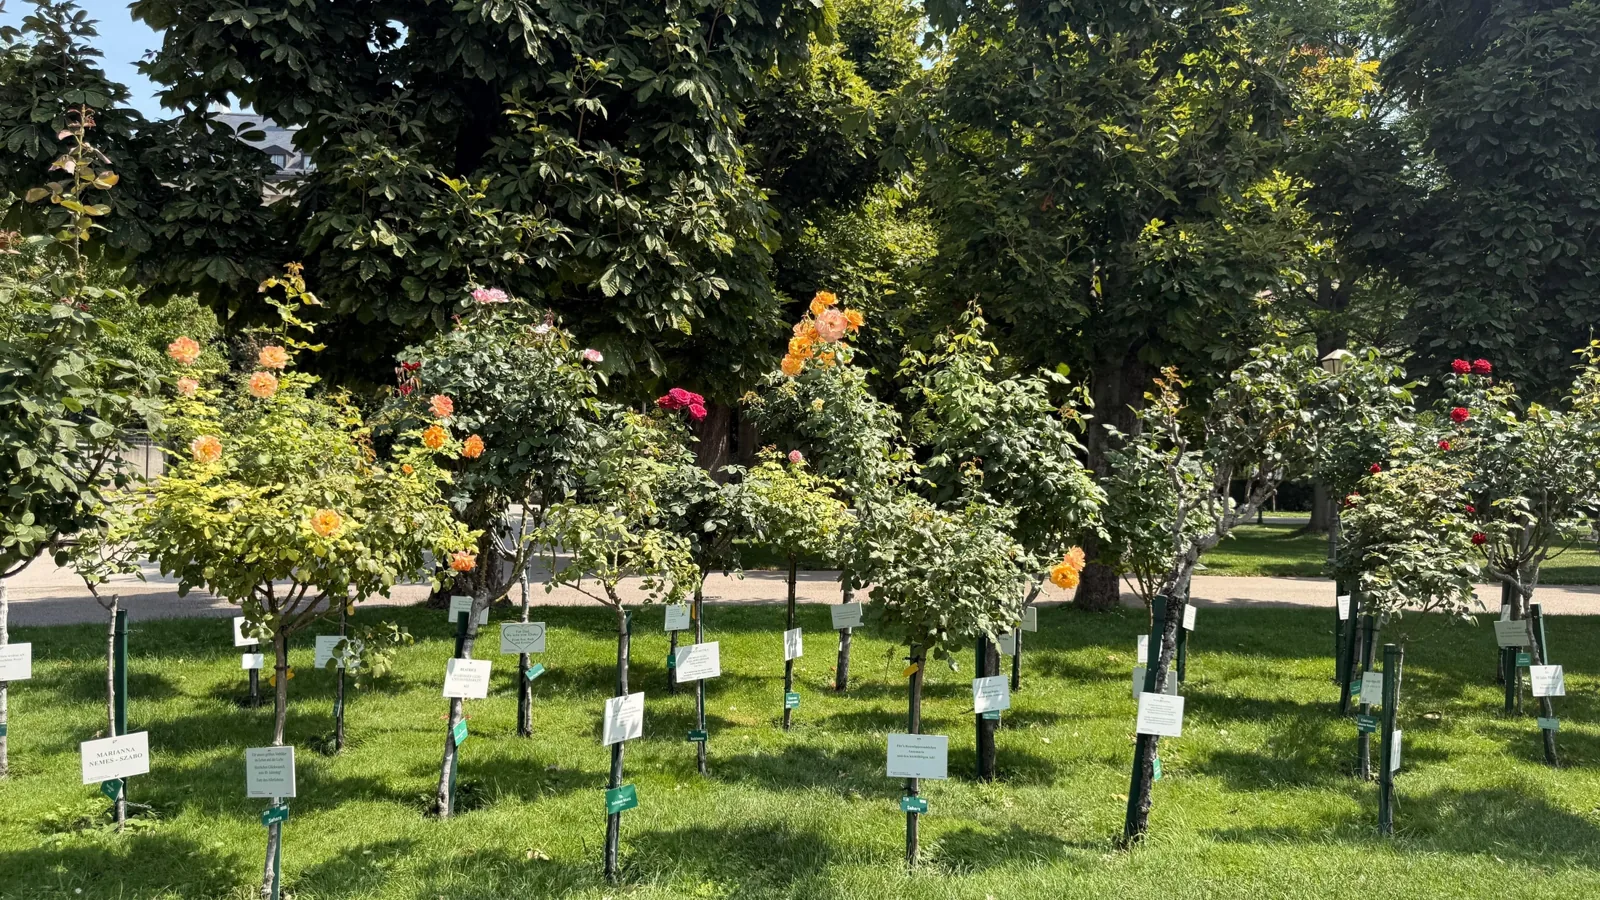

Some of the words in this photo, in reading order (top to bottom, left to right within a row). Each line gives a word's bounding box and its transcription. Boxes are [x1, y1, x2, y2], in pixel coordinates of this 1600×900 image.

[96, 747, 135, 758] MARIANNA
[89, 757, 114, 767] NEMES
[119, 752, 143, 762] SZABO
